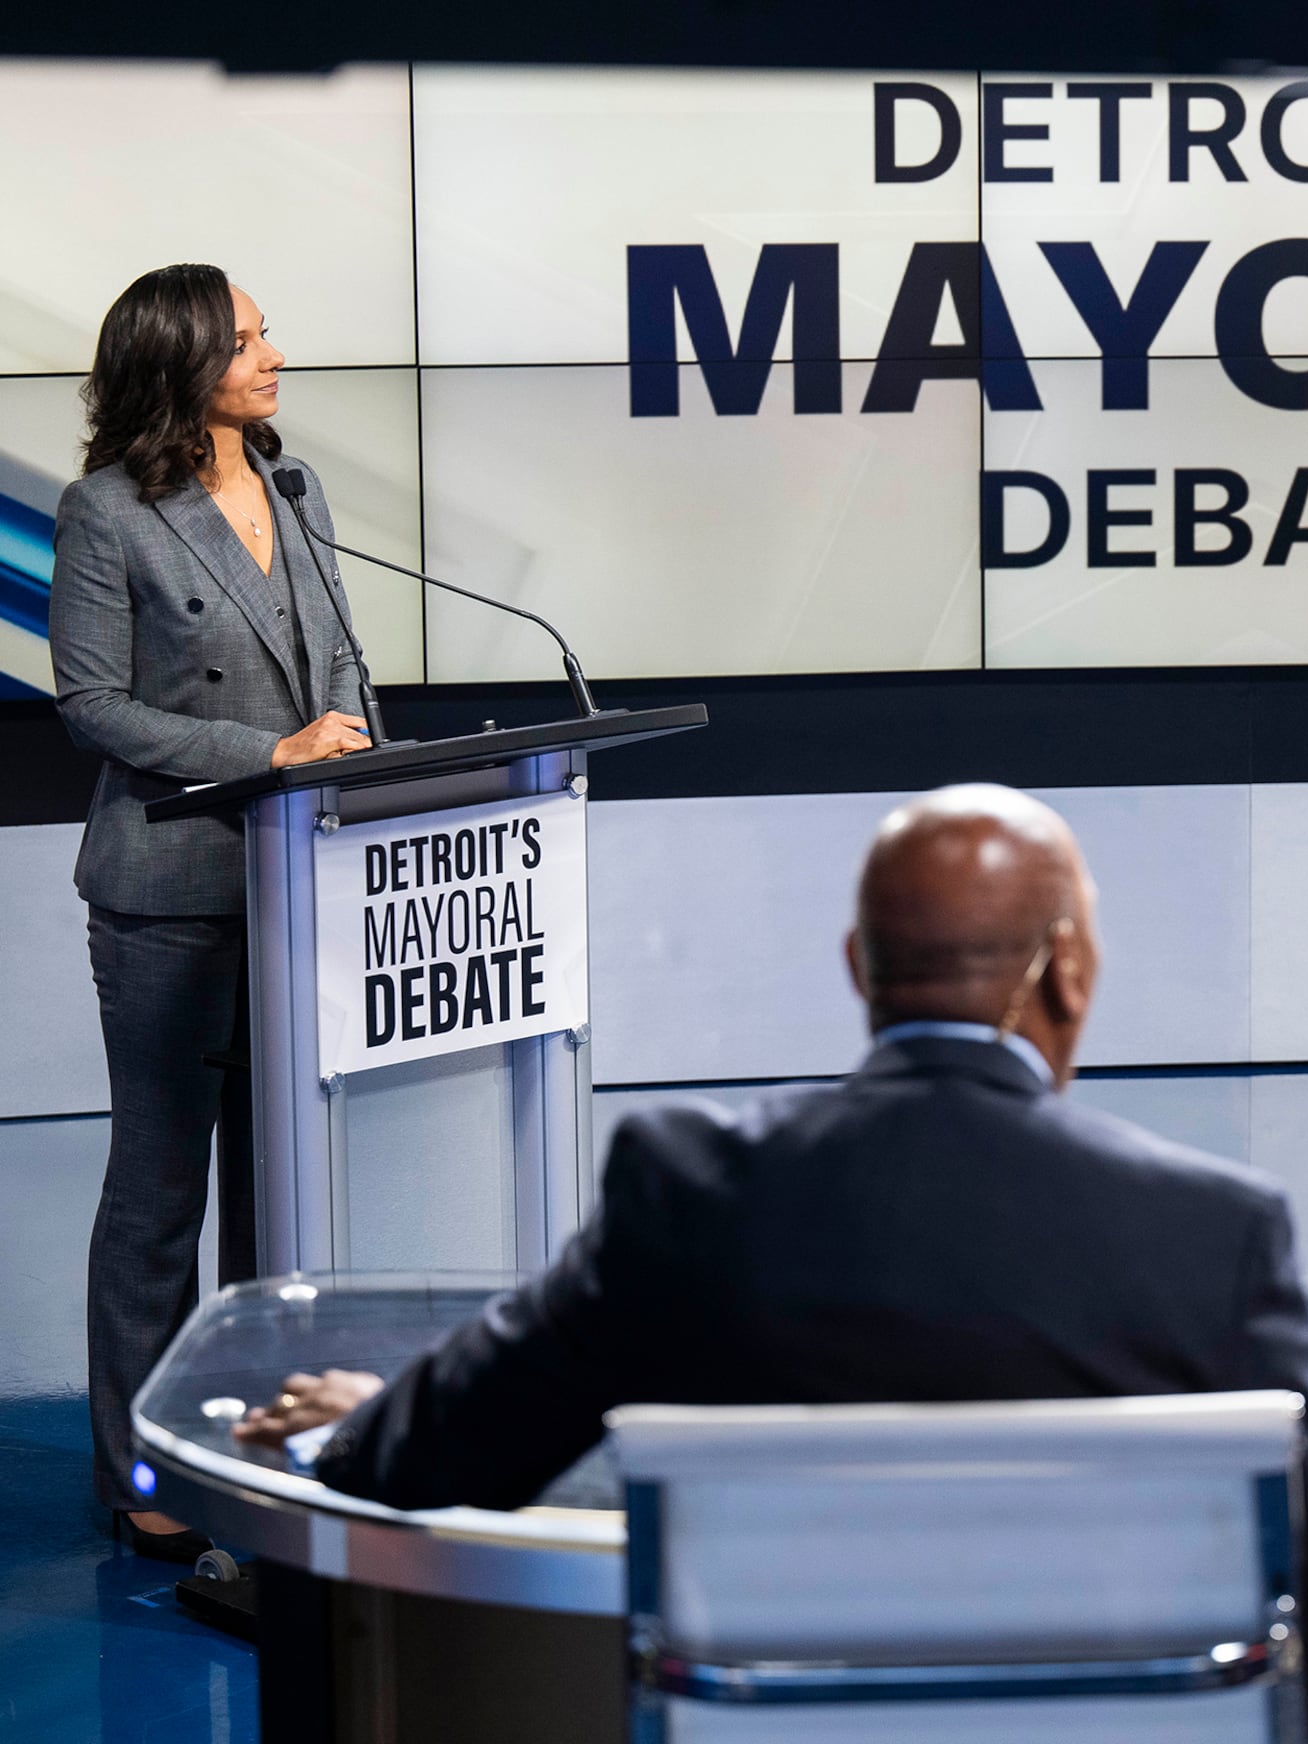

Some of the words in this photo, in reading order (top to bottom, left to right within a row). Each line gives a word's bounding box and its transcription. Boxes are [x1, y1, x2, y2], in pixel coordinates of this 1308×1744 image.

[365, 817, 541, 897] DETROIT'S
[364, 878, 545, 971] MAYORAL
[364, 943, 546, 1049] DEBATE
